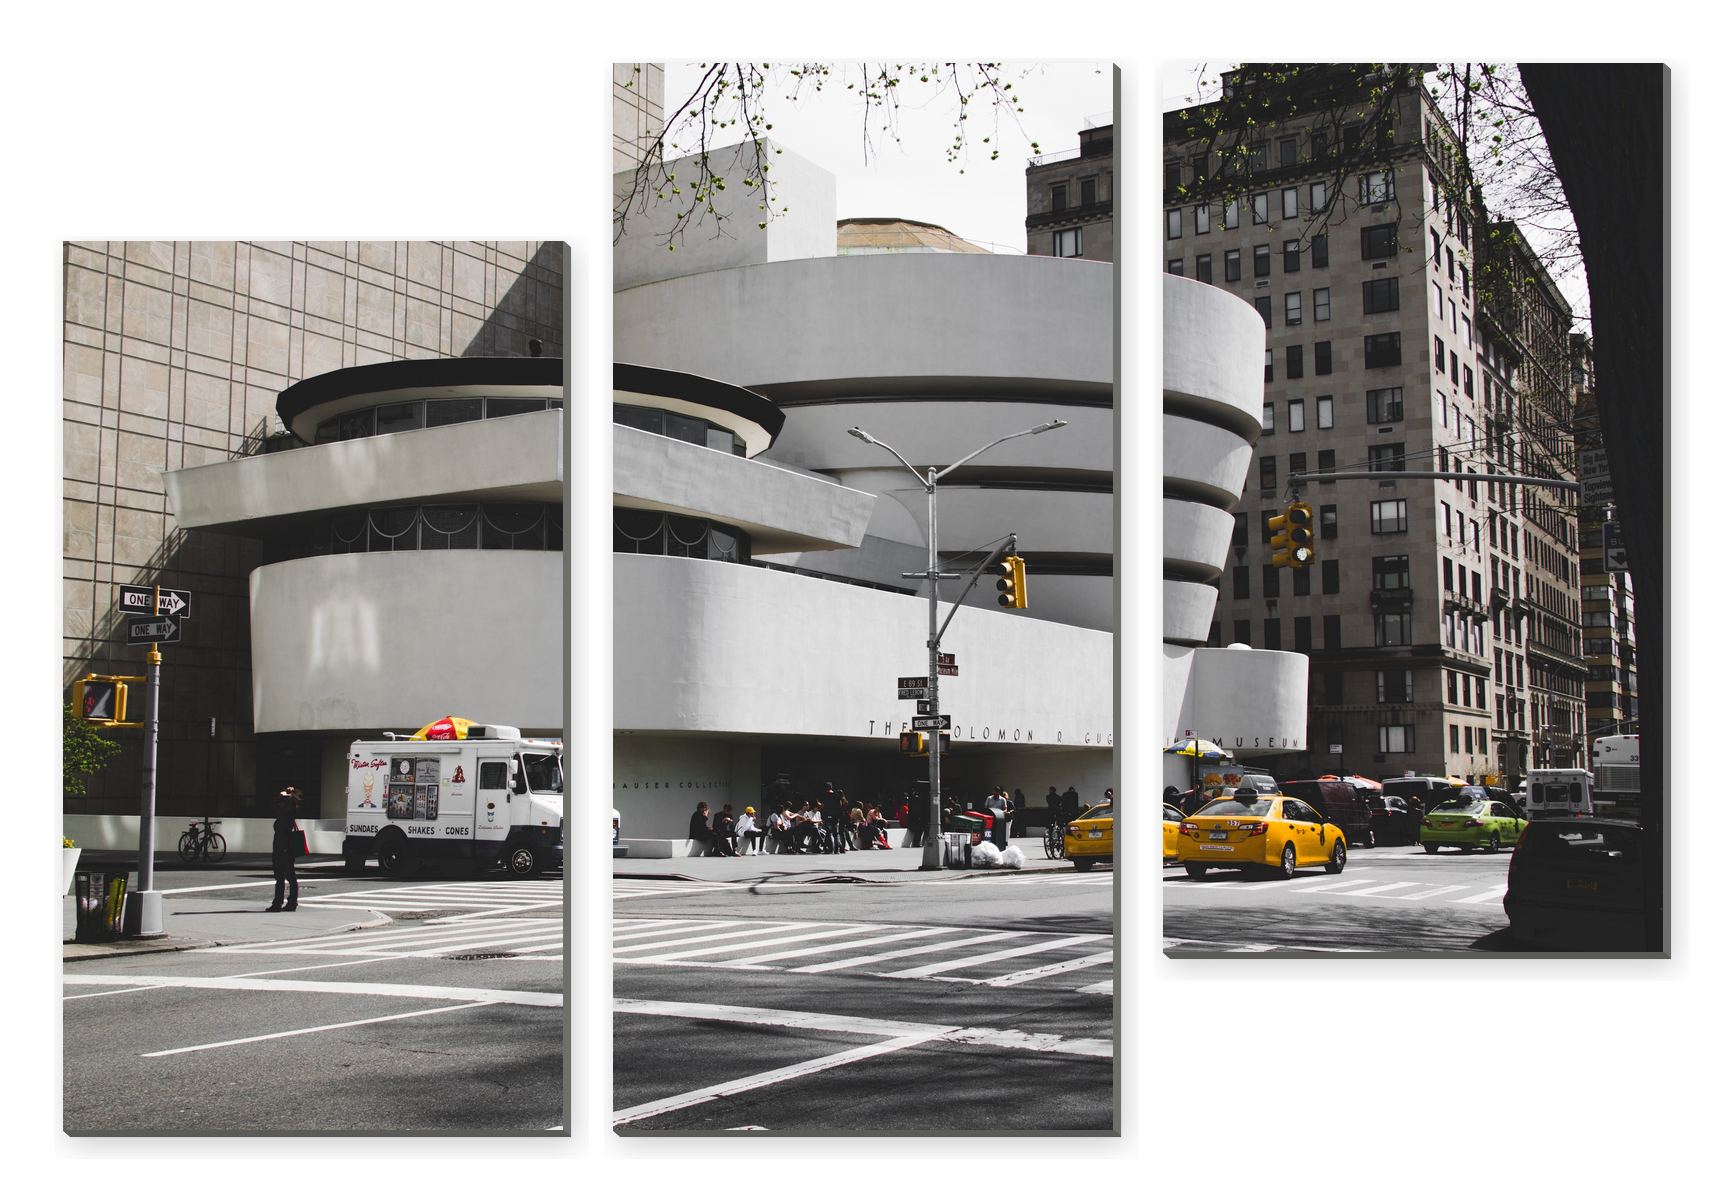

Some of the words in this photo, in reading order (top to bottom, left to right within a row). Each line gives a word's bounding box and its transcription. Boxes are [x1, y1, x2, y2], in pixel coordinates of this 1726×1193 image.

[1583, 454, 1593, 465] Big
[1595, 453, 1606, 462] Bus
[1583, 466, 1596, 475] New
[1598, 464, 1609, 472] Yor
[1584, 491, 1615, 504] Sightsee
[130, 594, 150, 606] ONE
[160, 598, 179, 608] WAY
[135, 625, 150, 635] ONE
[156, 623, 172, 634] WAY
[954, 725, 1033, 742] OLOMON
[1057, 731, 1062, 742] R
[1212, 737, 1298, 749] MUSEUM
[350, 824, 378, 833] SUNDAES
[408, 826, 435, 835] SHAKES
[445, 827, 469, 835] CONES
